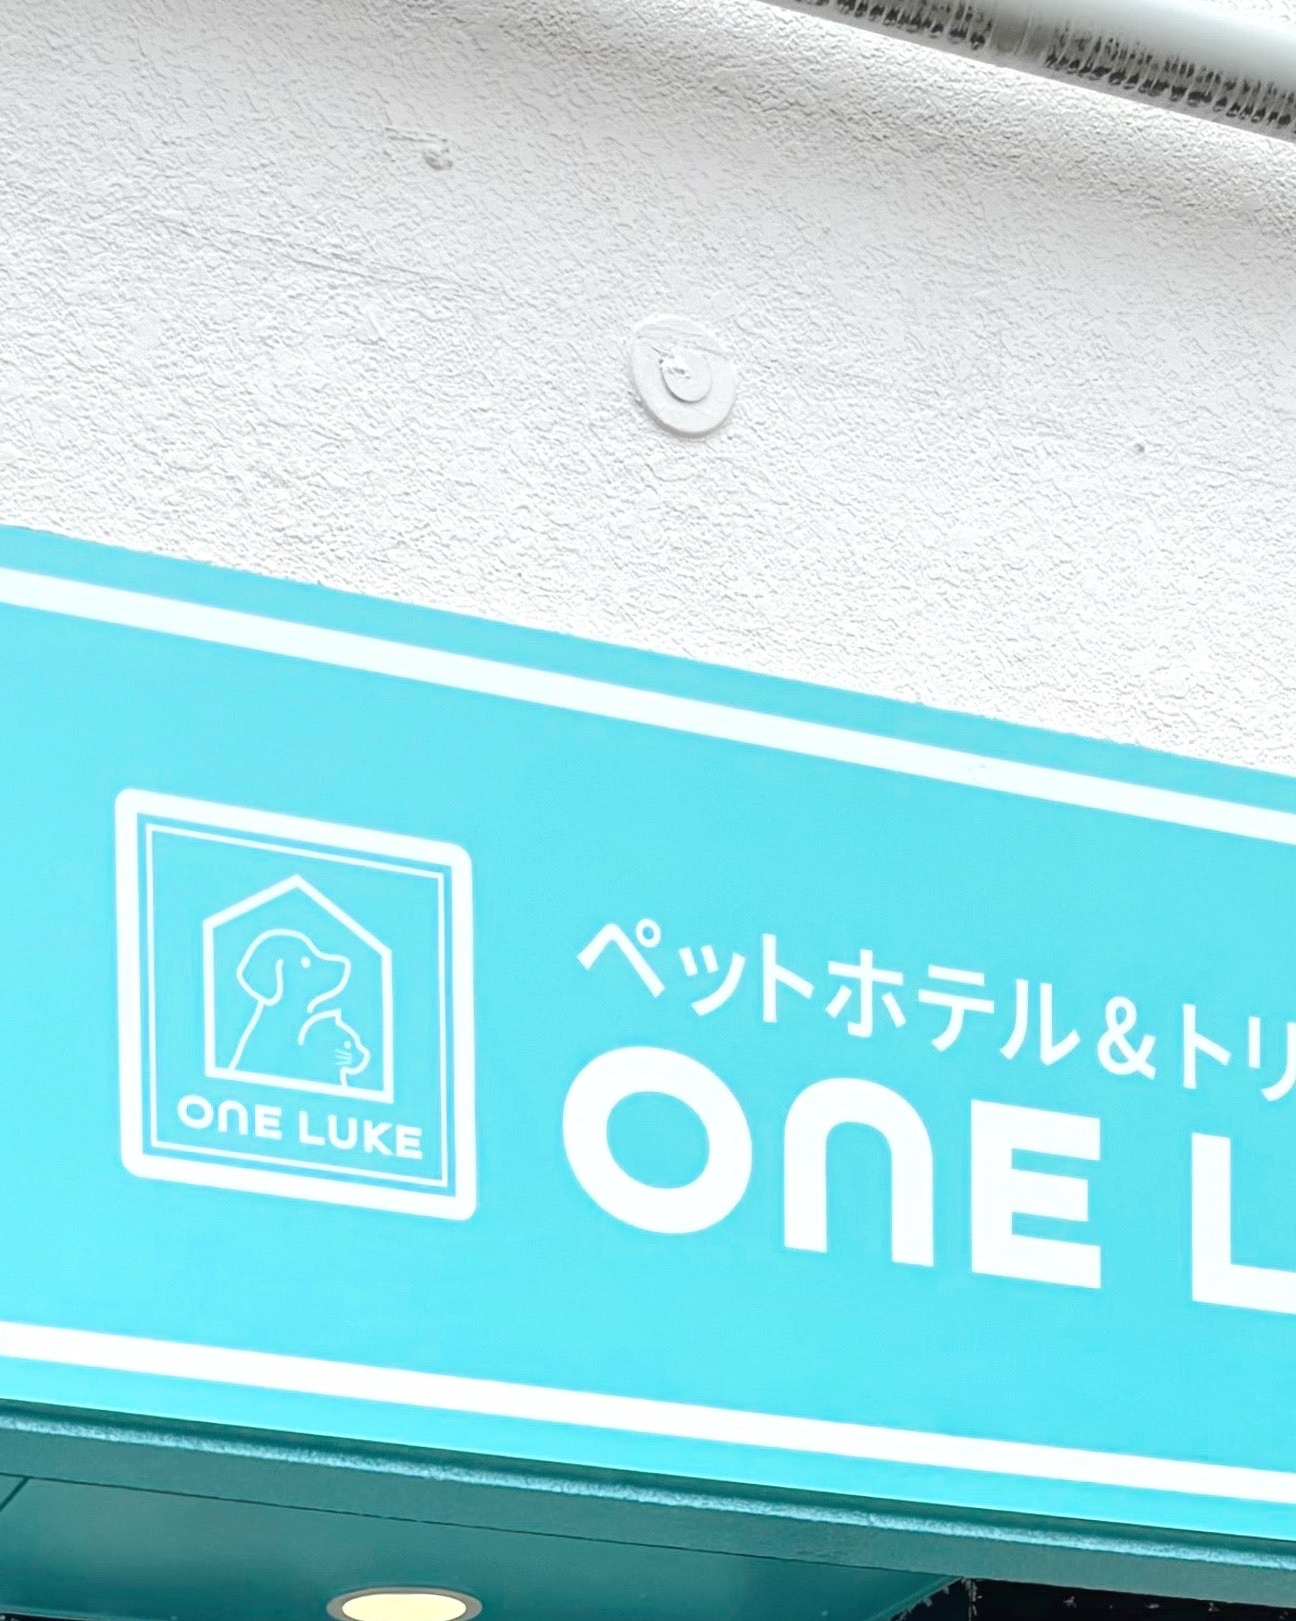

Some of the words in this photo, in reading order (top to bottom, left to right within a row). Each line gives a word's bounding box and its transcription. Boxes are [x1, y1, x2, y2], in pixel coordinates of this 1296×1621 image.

[177, 1094, 283, 1141] ONE
[299, 1110, 423, 1160] LUKE
[562, 1043, 1102, 1289] ONE
